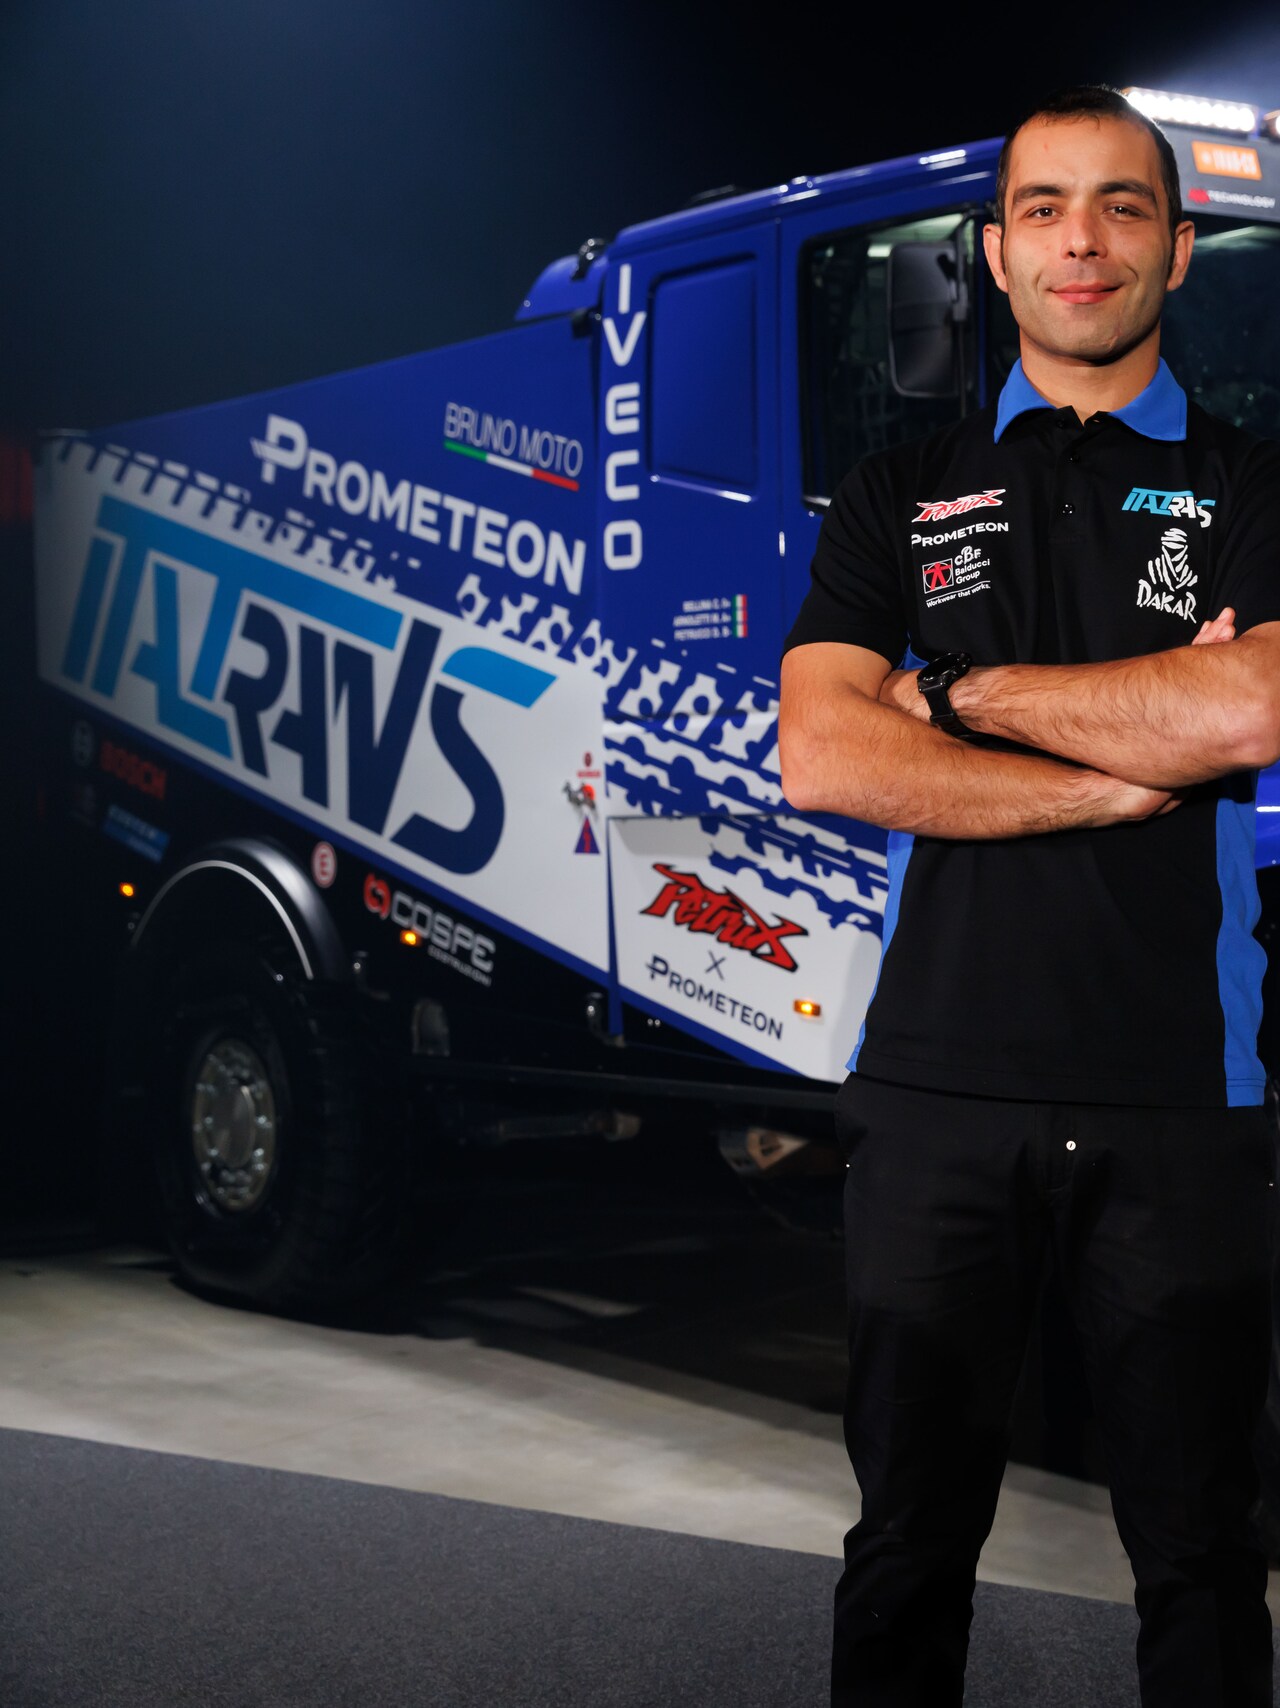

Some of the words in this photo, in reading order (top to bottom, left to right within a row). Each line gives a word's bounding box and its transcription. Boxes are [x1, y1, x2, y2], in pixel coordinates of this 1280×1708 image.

[444, 401, 517, 457] BRUNO
[519, 424, 583, 478] MOTO
[602, 263, 647, 571] IVECO
[251, 413, 587, 596] PROMETEON
[911, 522, 1009, 550] PROMETEON
[926, 593, 957, 608] Workwear
[957, 588, 972, 599] that
[954, 558, 991, 577] Balducci
[955, 570, 981, 585] Group
[1136, 579, 1197, 624] DAKAR
[391, 890, 497, 973] COSPE
[645, 954, 783, 1041] PROMETEON
